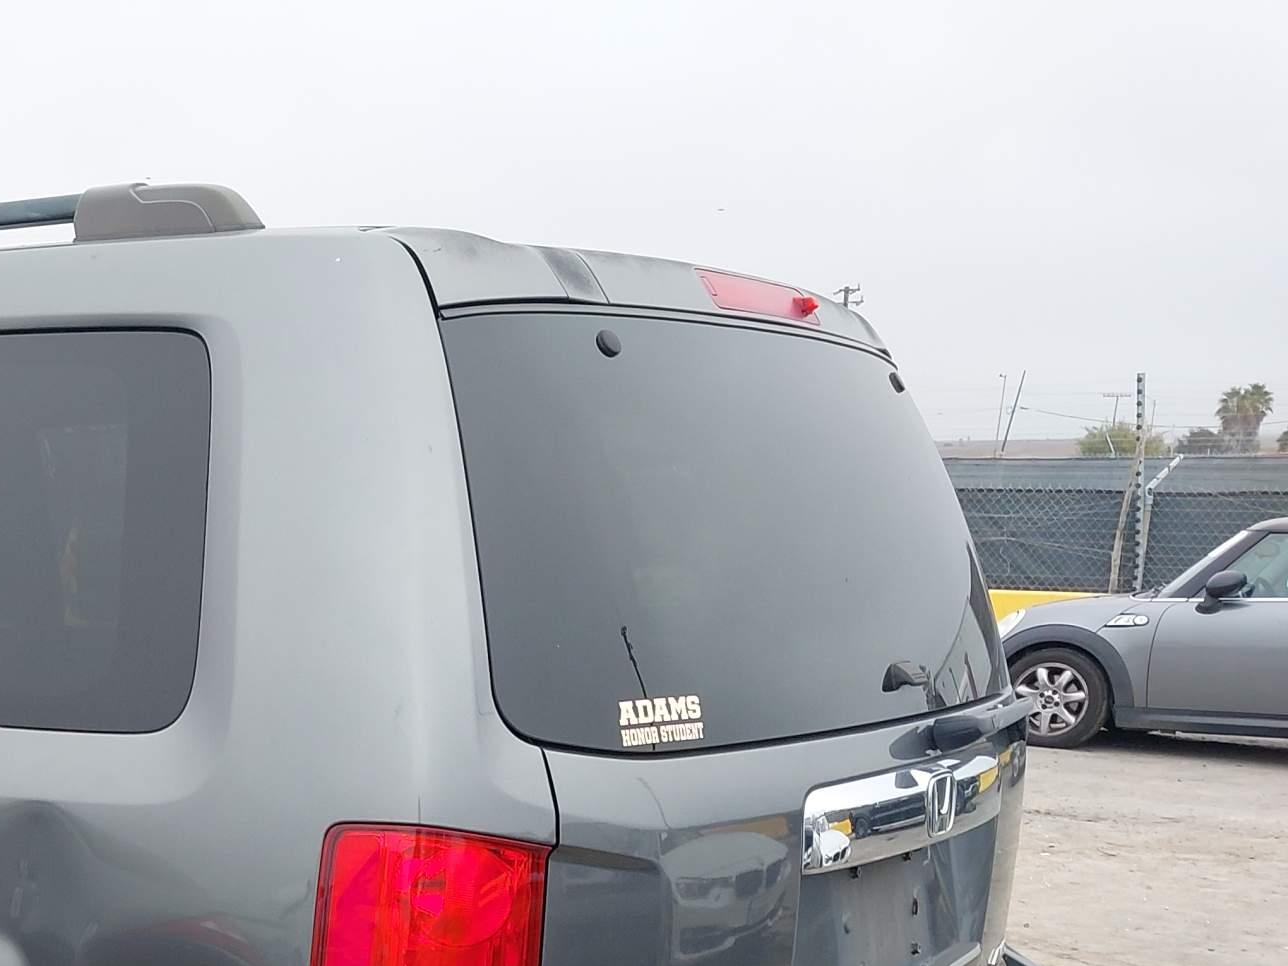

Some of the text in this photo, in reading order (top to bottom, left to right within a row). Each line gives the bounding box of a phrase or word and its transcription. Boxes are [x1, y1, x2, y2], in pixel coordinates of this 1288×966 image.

[619, 695, 701, 726] ADAMS
[621, 722, 704, 747] HONOR STUDENT
